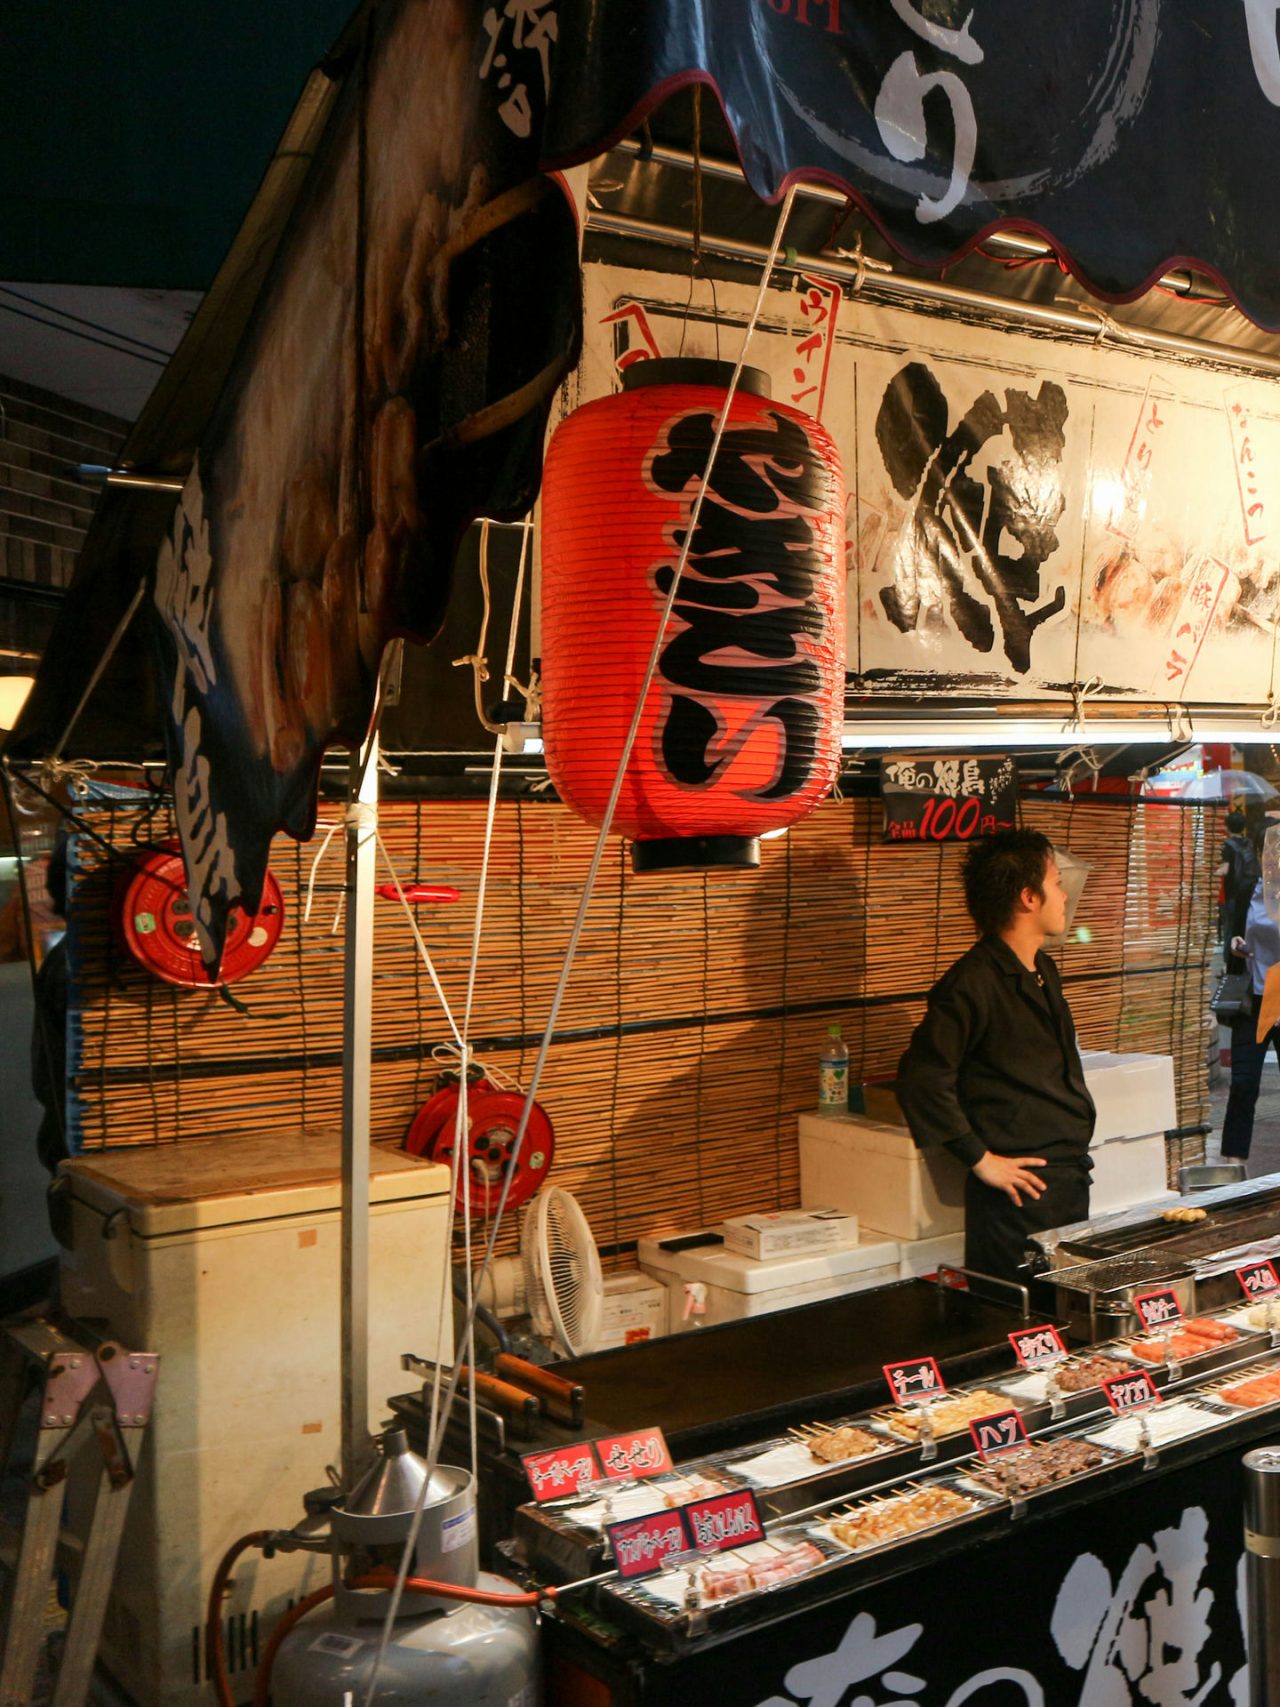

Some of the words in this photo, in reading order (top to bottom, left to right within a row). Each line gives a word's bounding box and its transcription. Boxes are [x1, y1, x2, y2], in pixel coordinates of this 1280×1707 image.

[885, 759, 986, 799] 俺の焼鳥
[607, 1437, 664, 1472] せせり
